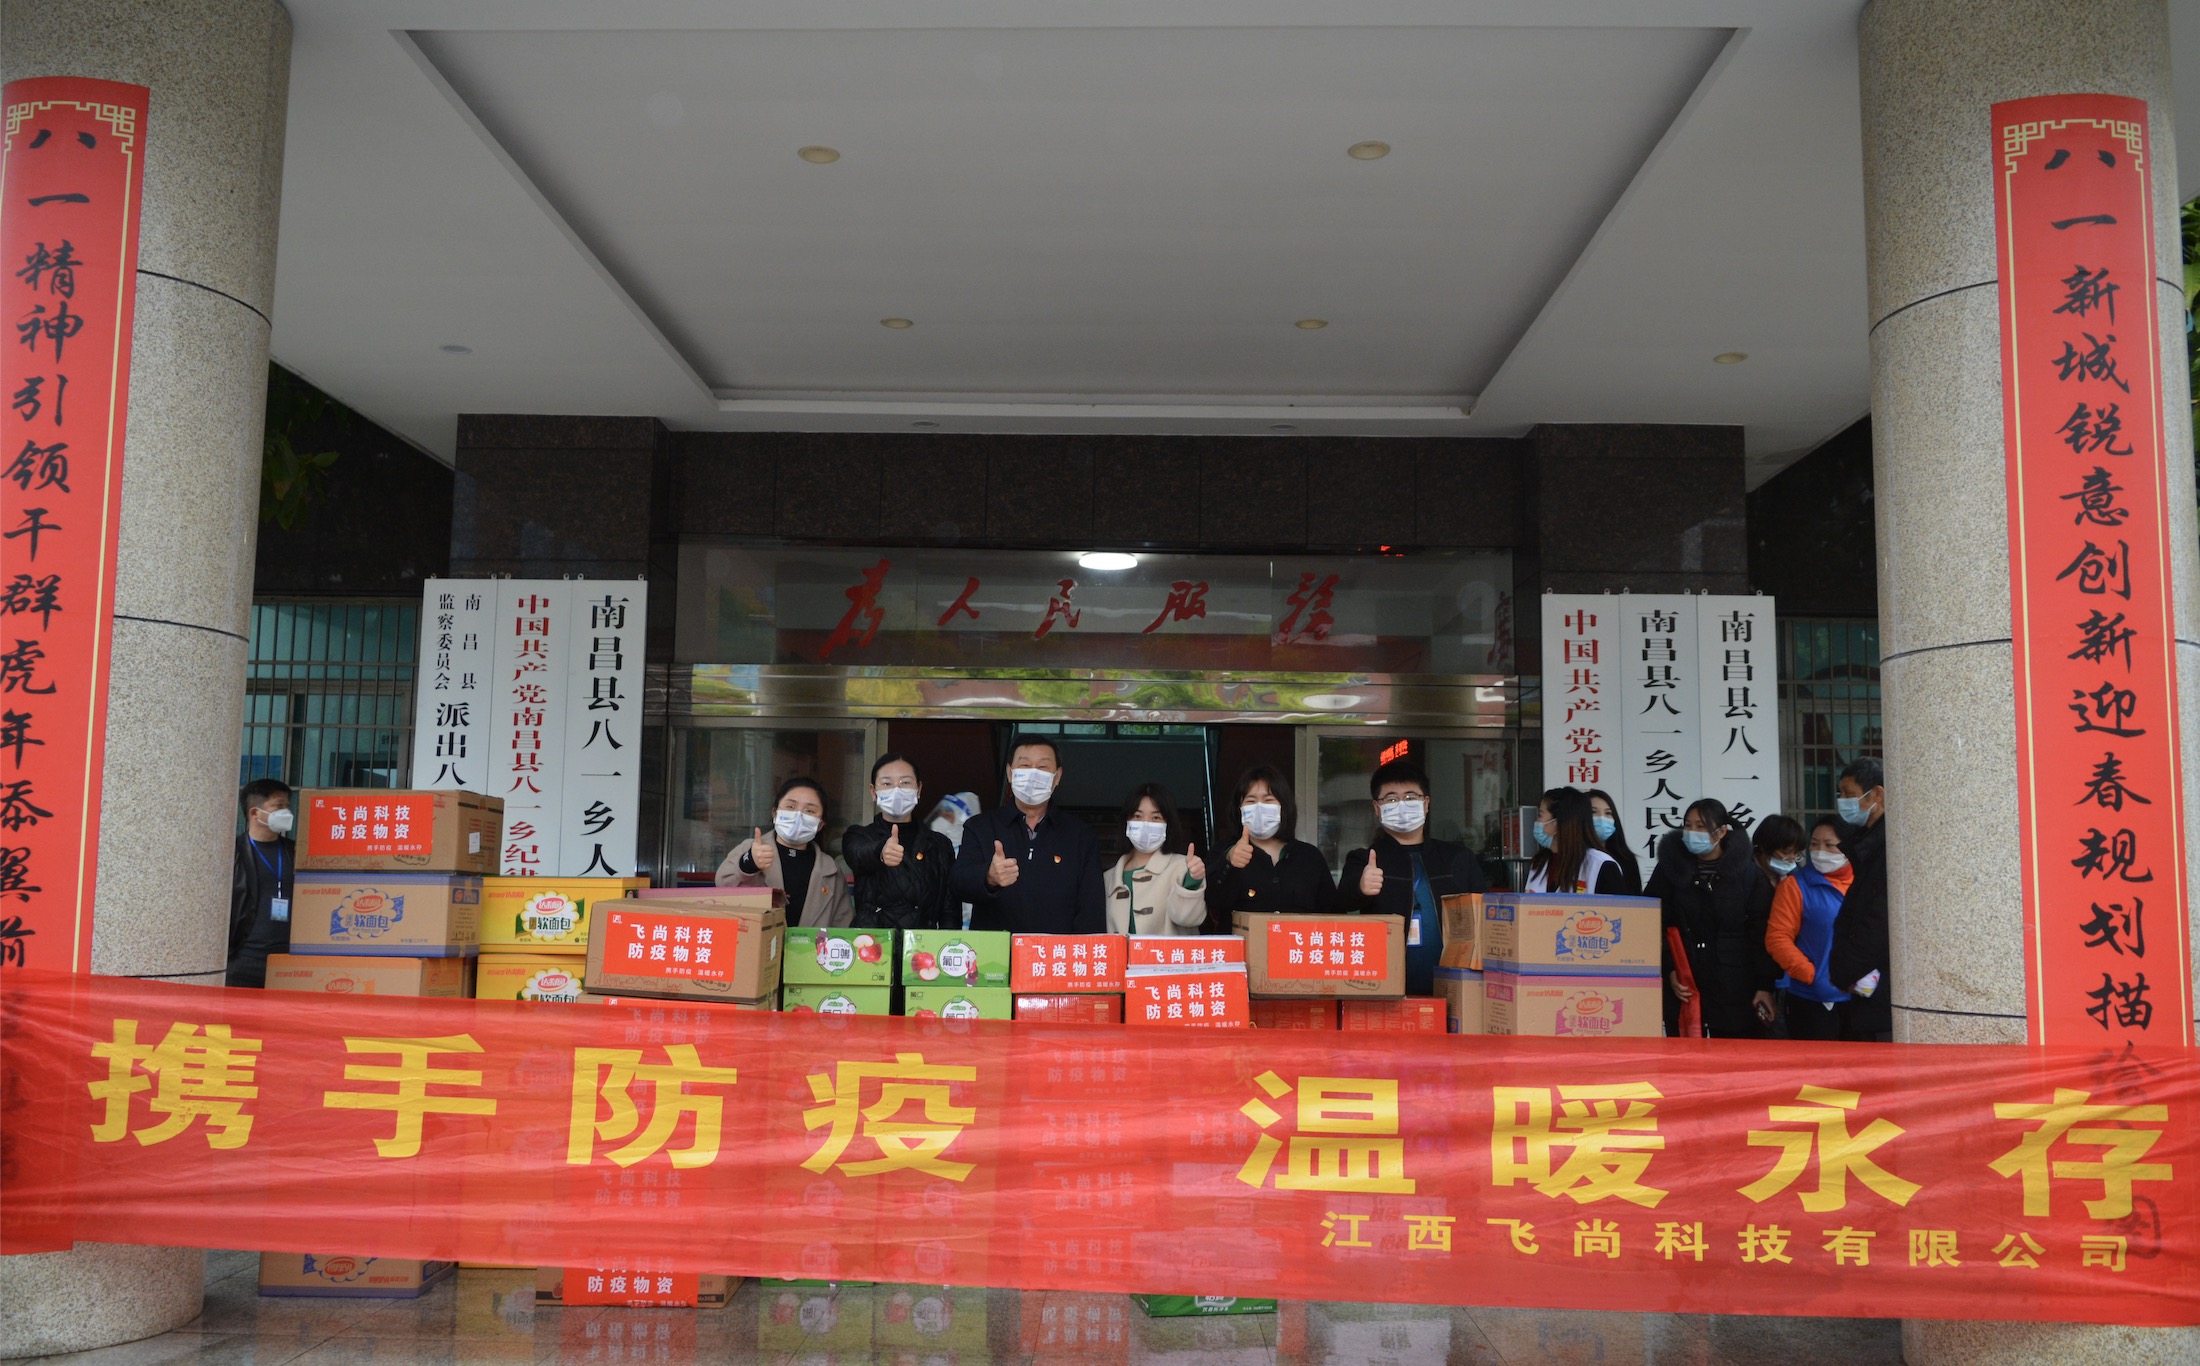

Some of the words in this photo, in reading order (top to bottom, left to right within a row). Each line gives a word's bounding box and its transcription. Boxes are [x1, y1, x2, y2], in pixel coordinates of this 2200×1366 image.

[434, 593, 455, 690] 监察委员会
[461, 593, 481, 690] 南昌县
[1564, 609, 1602, 793] 中国共产党南
[431, 702, 470, 786] 派出八
[504, 594, 550, 876] 中国共产党南昌县八一乡纪
[577, 595, 629, 877] 南昌县八一乡人
[1637, 609, 1684, 876] 南昌县八一乡人民
[332, 805, 411, 821] 飞尚科技
[330, 824, 410, 840] 防疫物资
[354, 915, 389, 928] 软面包
[538, 917, 571, 930] 软面包
[630, 924, 714, 945] 飞尚科技
[1289, 931, 1365, 947] 飞尚科技
[1577, 936, 1609, 949] 软面包
[628, 943, 712, 964] 防疫物资
[1032, 944, 1107, 959] 飞尚科技
[1150, 949, 1226, 963] 飞尚科技
[1289, 949, 1365, 965] 防疫物资
[1032, 962, 1107, 977] 防疫物资
[1145, 982, 1225, 1000] 飞尚科技
[1146, 1000, 1226, 1020] 防疫物资
[1577, 1016, 1610, 1030] 软面包
[88, 1018, 977, 1183] 携手防疫
[1236, 1069, 2174, 1220] 温暖永存
[1320, 1210, 2128, 1273] 江西飞尚科技有限公司
[588, 1276, 673, 1294] 防疫物资
